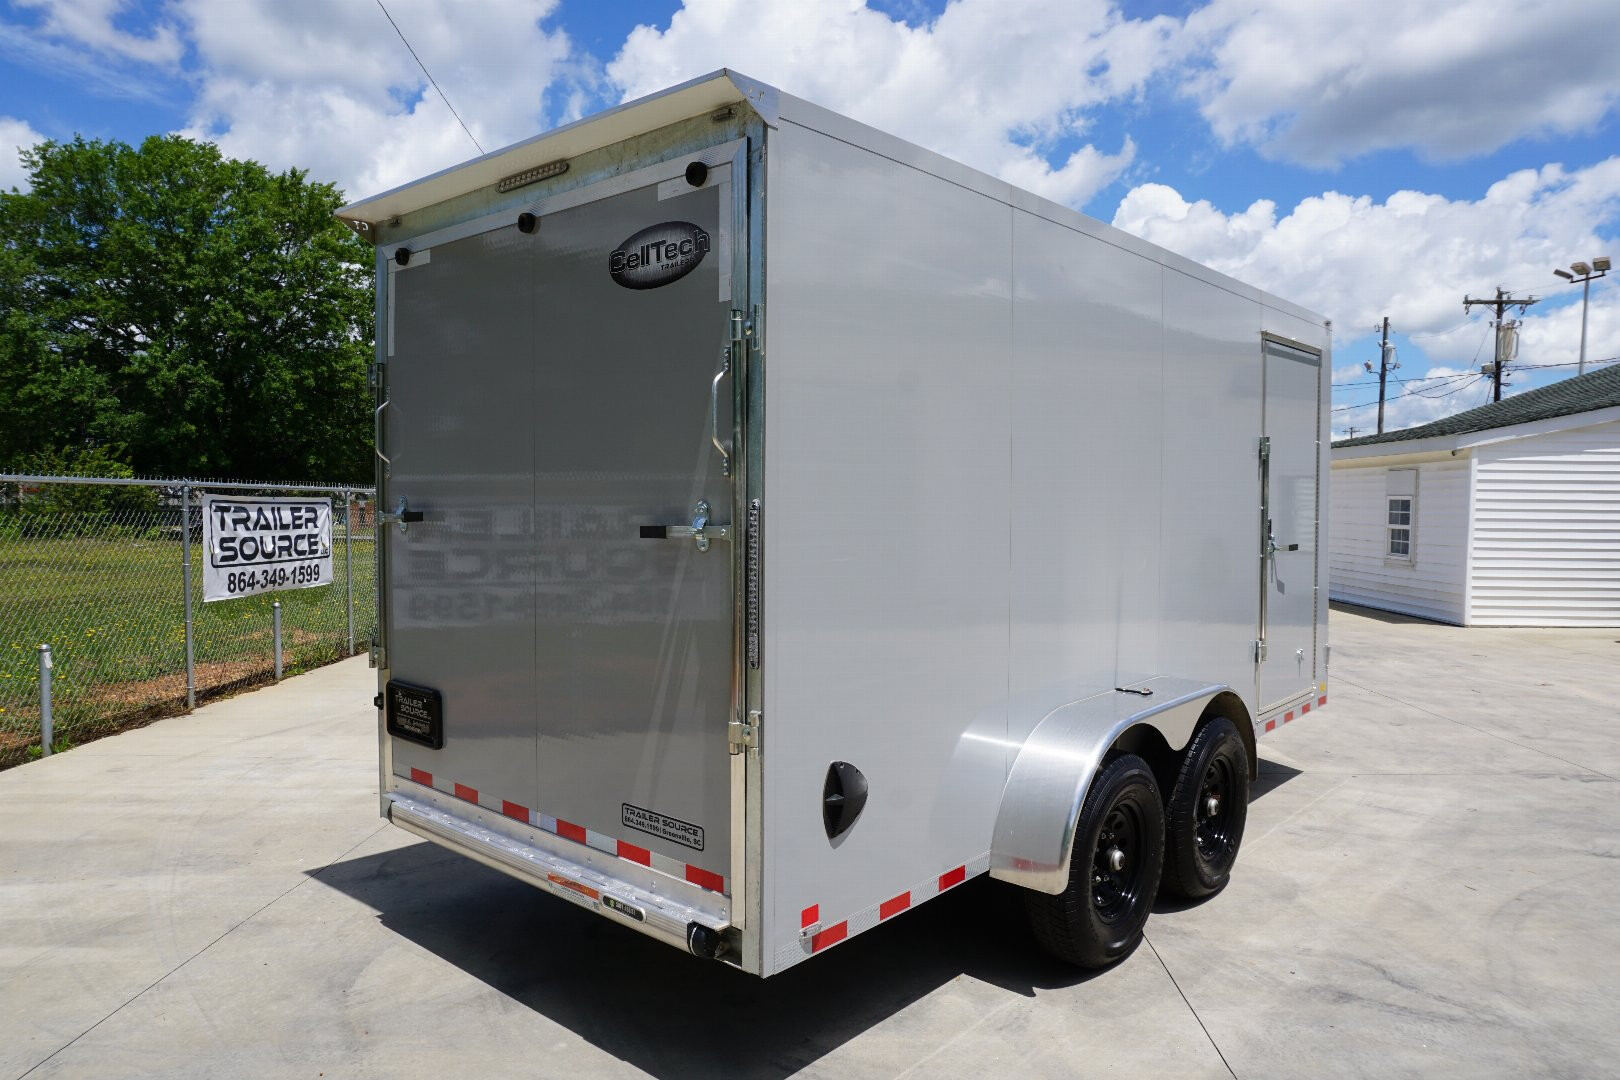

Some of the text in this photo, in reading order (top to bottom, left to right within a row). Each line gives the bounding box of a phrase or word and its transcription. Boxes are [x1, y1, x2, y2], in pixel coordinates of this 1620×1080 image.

[609, 229, 711, 274] CellTech
[214, 505, 319, 531] TRAILER
[219, 533, 319, 562] SOURCE
[228, 563, 320, 593] 864-349-1599
[395, 694, 423, 709] TRAILER
[400, 704, 428, 719] SOURCE
[624, 807, 699, 837] TRAILER SOURCE
